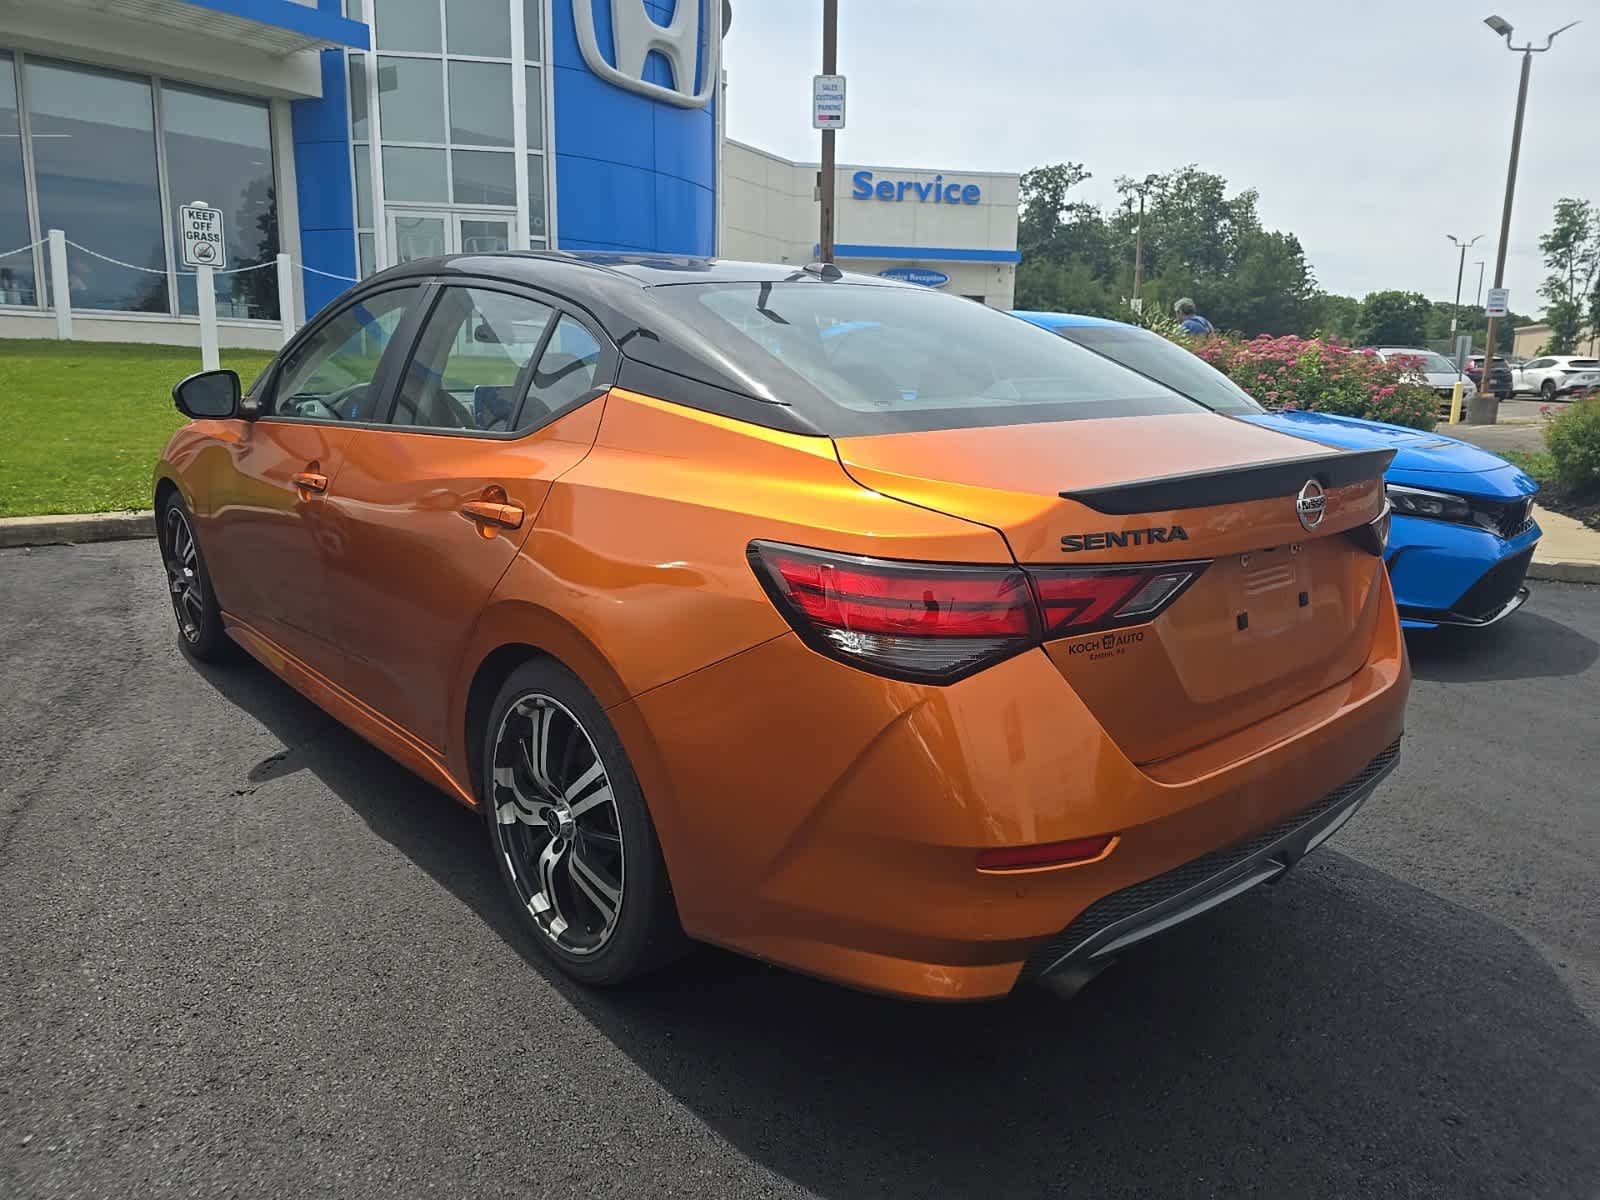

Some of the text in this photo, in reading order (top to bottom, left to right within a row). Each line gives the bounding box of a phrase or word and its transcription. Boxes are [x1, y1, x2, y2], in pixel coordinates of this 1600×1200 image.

[853, 171, 981, 205] Service
[188, 210, 215, 221] KEEP
[193, 221, 212, 231] OFF
[186, 231, 220, 243] GRASS
[1061, 526, 1188, 552] SENTRA
[1068, 640, 1100, 655] KOCH
[1115, 632, 1144, 647] AUTO
